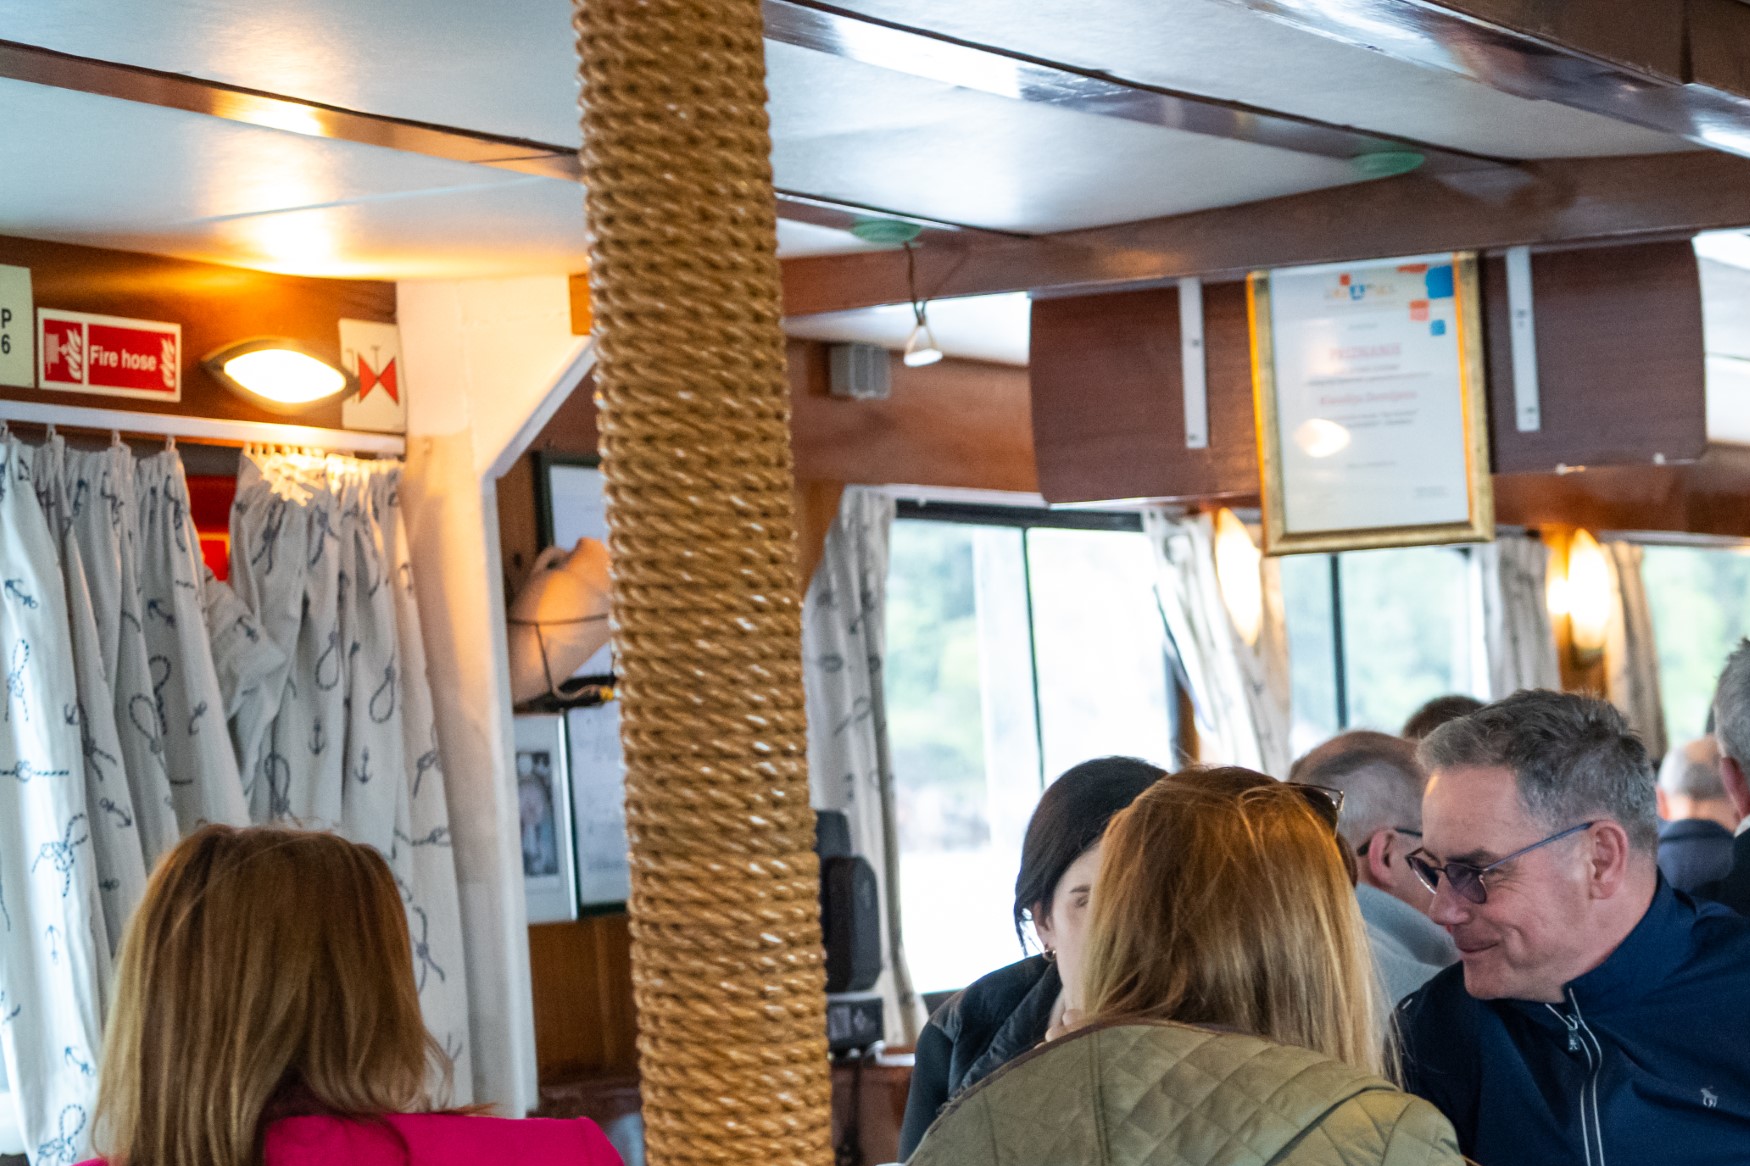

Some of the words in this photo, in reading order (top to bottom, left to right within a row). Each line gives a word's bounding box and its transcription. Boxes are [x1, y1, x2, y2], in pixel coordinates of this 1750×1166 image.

[1, 308, 12, 329] P
[1, 334, 11, 354] 6
[90, 345, 118, 368] Fire
[121, 349, 157, 372] hose
